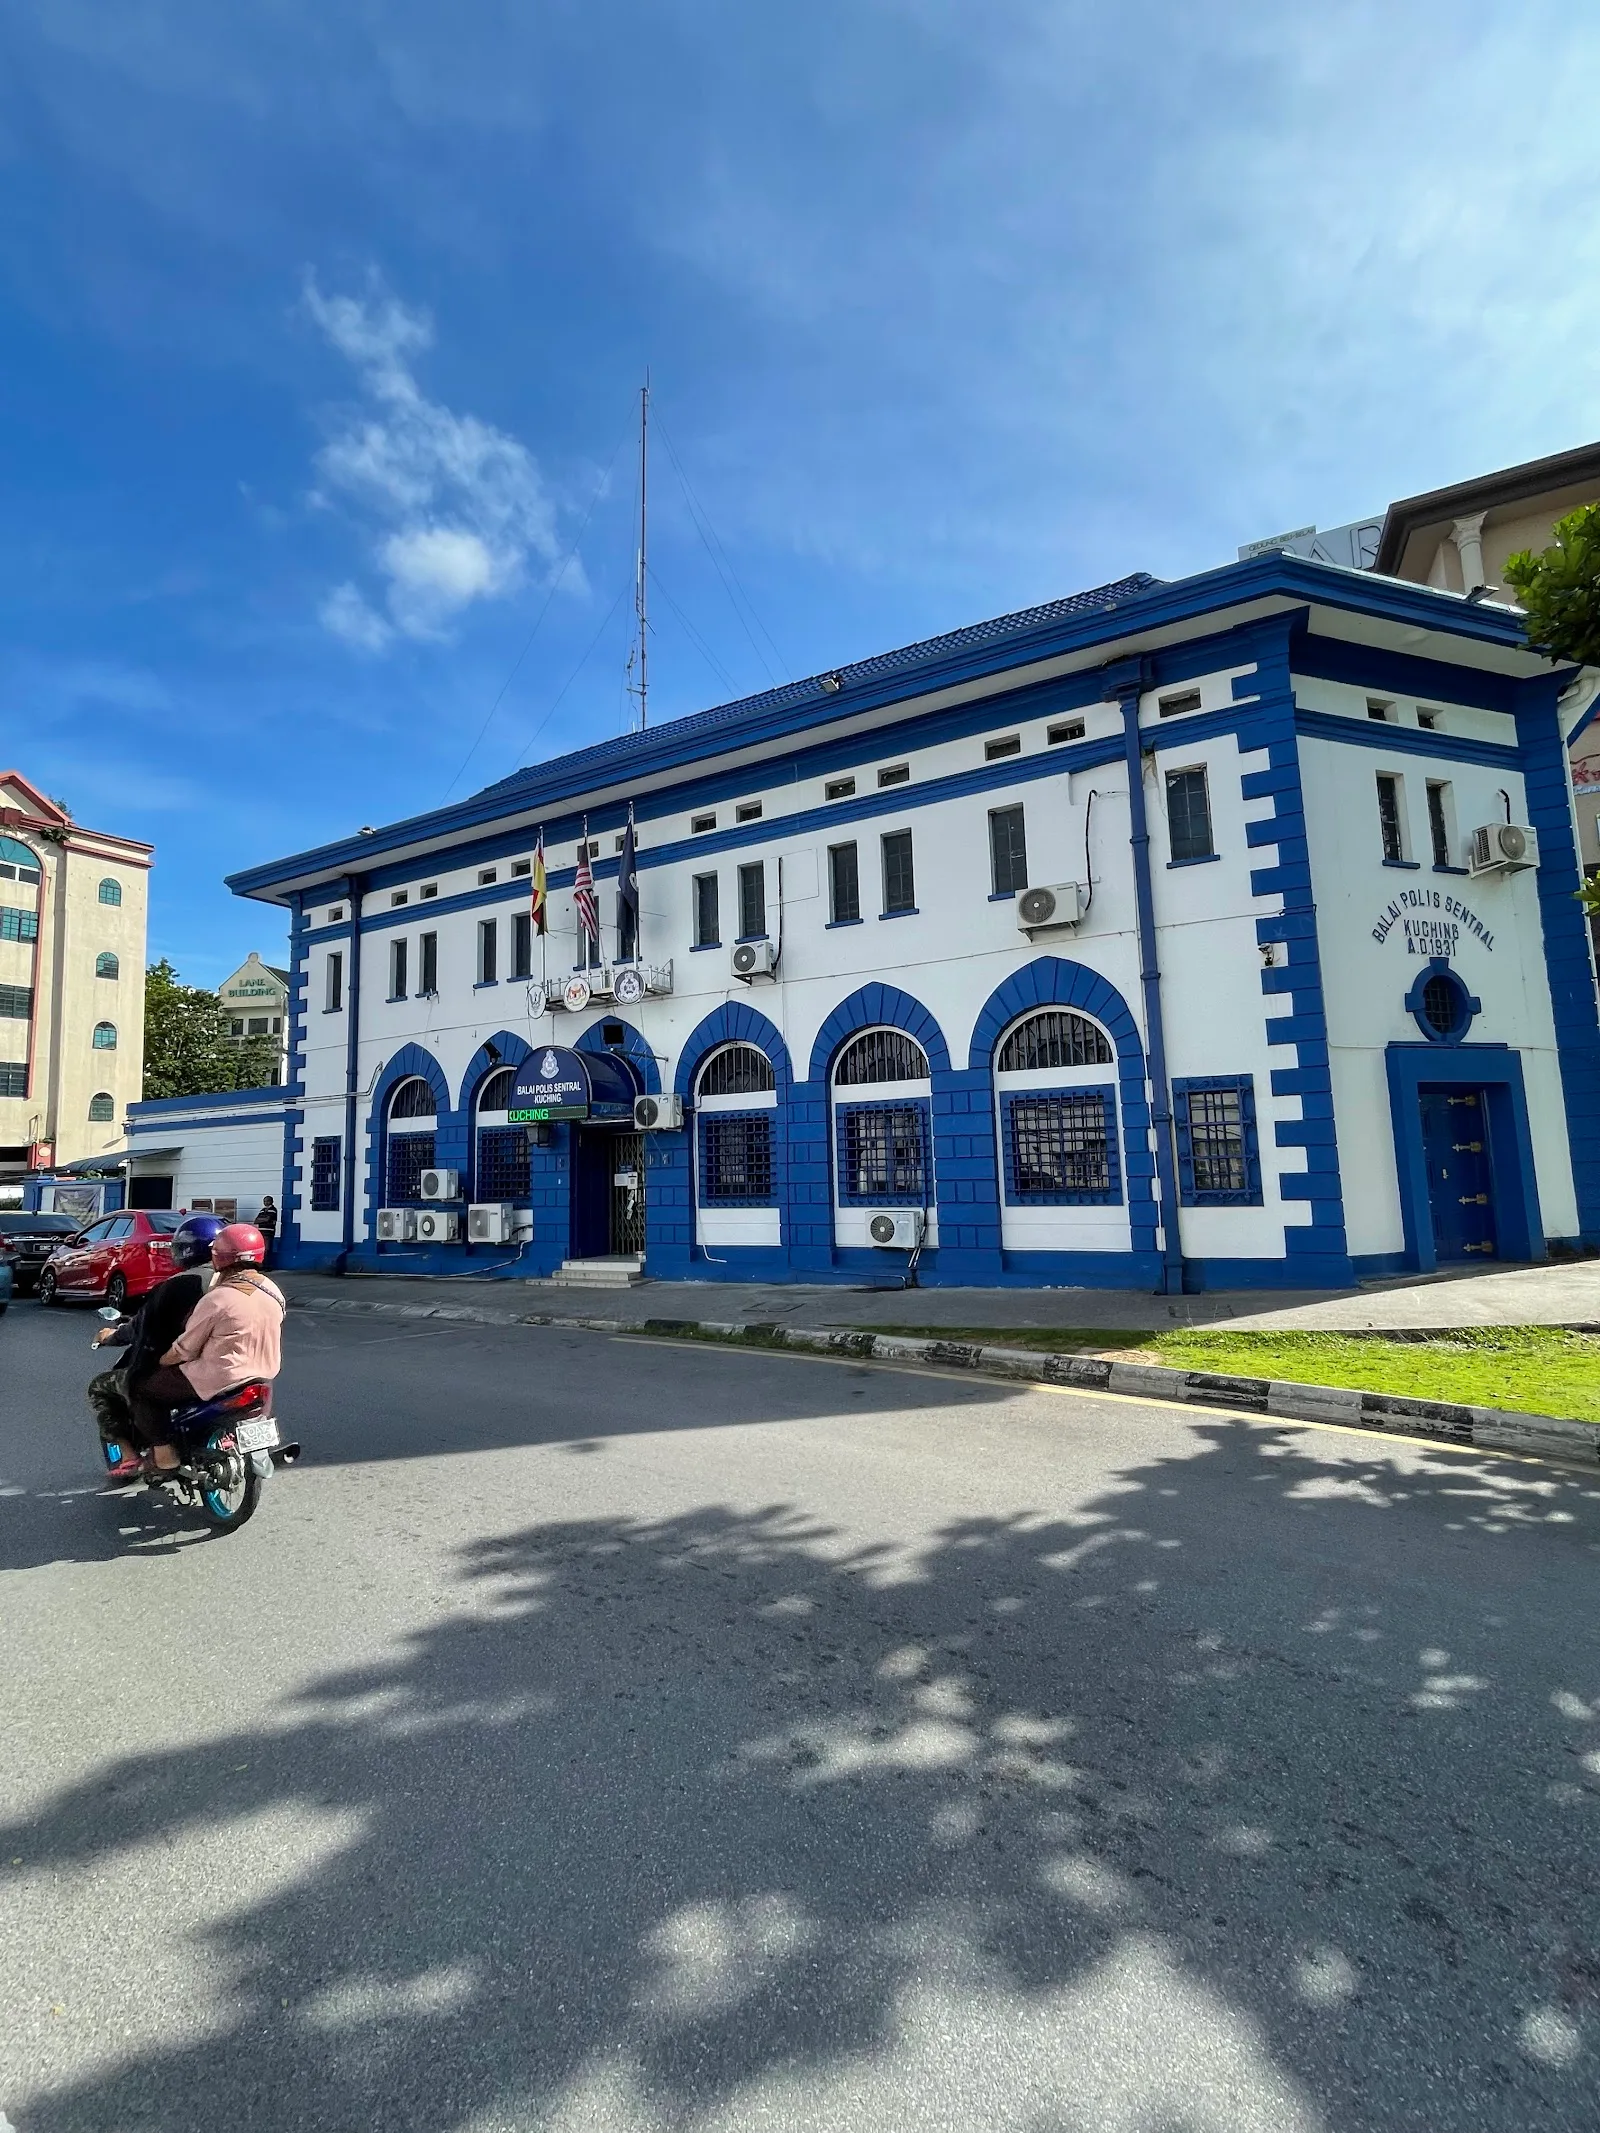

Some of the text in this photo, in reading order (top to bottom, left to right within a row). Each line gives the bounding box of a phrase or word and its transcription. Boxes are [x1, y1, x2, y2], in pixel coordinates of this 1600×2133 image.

[1372, 888, 1494, 951] BALAI POLIS SENTRAL
[1403, 919, 1459, 940] KUCHING
[239, 978, 266, 987] LANE
[228, 988, 276, 997] BUILDING
[517, 1081, 581, 1095] BALAI POLIS SENTRAL
[534, 1093, 562, 1104] KUCHING
